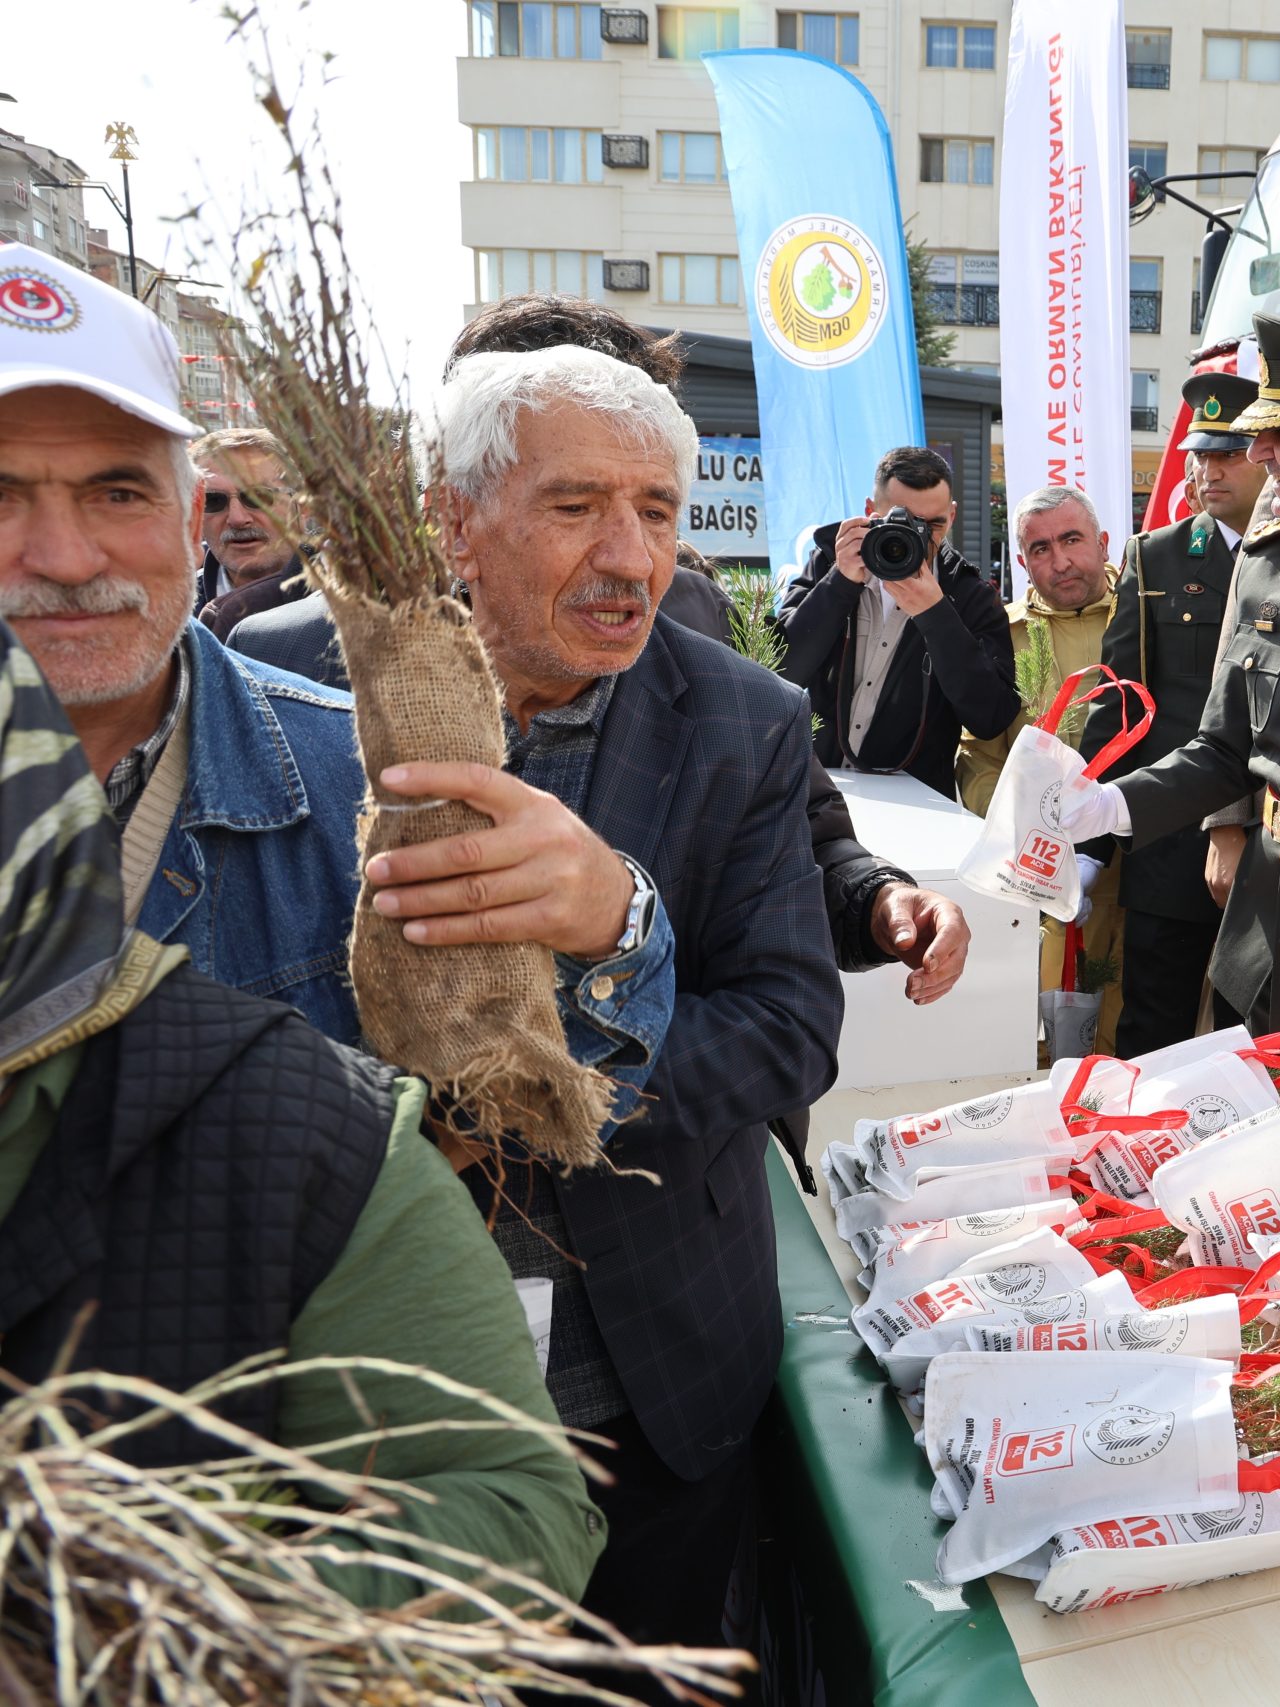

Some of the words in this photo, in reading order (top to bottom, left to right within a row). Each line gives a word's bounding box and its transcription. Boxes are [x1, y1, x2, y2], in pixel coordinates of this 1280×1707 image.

[697, 455, 725, 481] LU
[733, 455, 763, 481] CA
[689, 499, 758, 539] BAĞIŞ
[1030, 836, 1061, 863] 112
[1139, 1149, 1153, 1168] ACİL
[1147, 1132, 1181, 1164] 112
[1104, 1162, 1124, 1186] İŞLETME
[1115, 1165, 1131, 1185] SİVAS
[1189, 1197, 1203, 1218] ORMAN
[1208, 1190, 1222, 1213] ORMAN
[1218, 1211, 1235, 1237] YANGINI
[1231, 1234, 1241, 1257] İHBAR
[1211, 1224, 1226, 1246] SİVAS
[924, 1301, 941, 1318] ACİL
[895, 1315, 913, 1332] SİVAS
[1057, 1322, 1088, 1352] 112
[964, 1417, 975, 1443] ORMAN
[991, 1417, 1001, 1441] ORMAN
[1030, 1431, 1065, 1461] 112
[983, 1477, 996, 1504] HATTI
